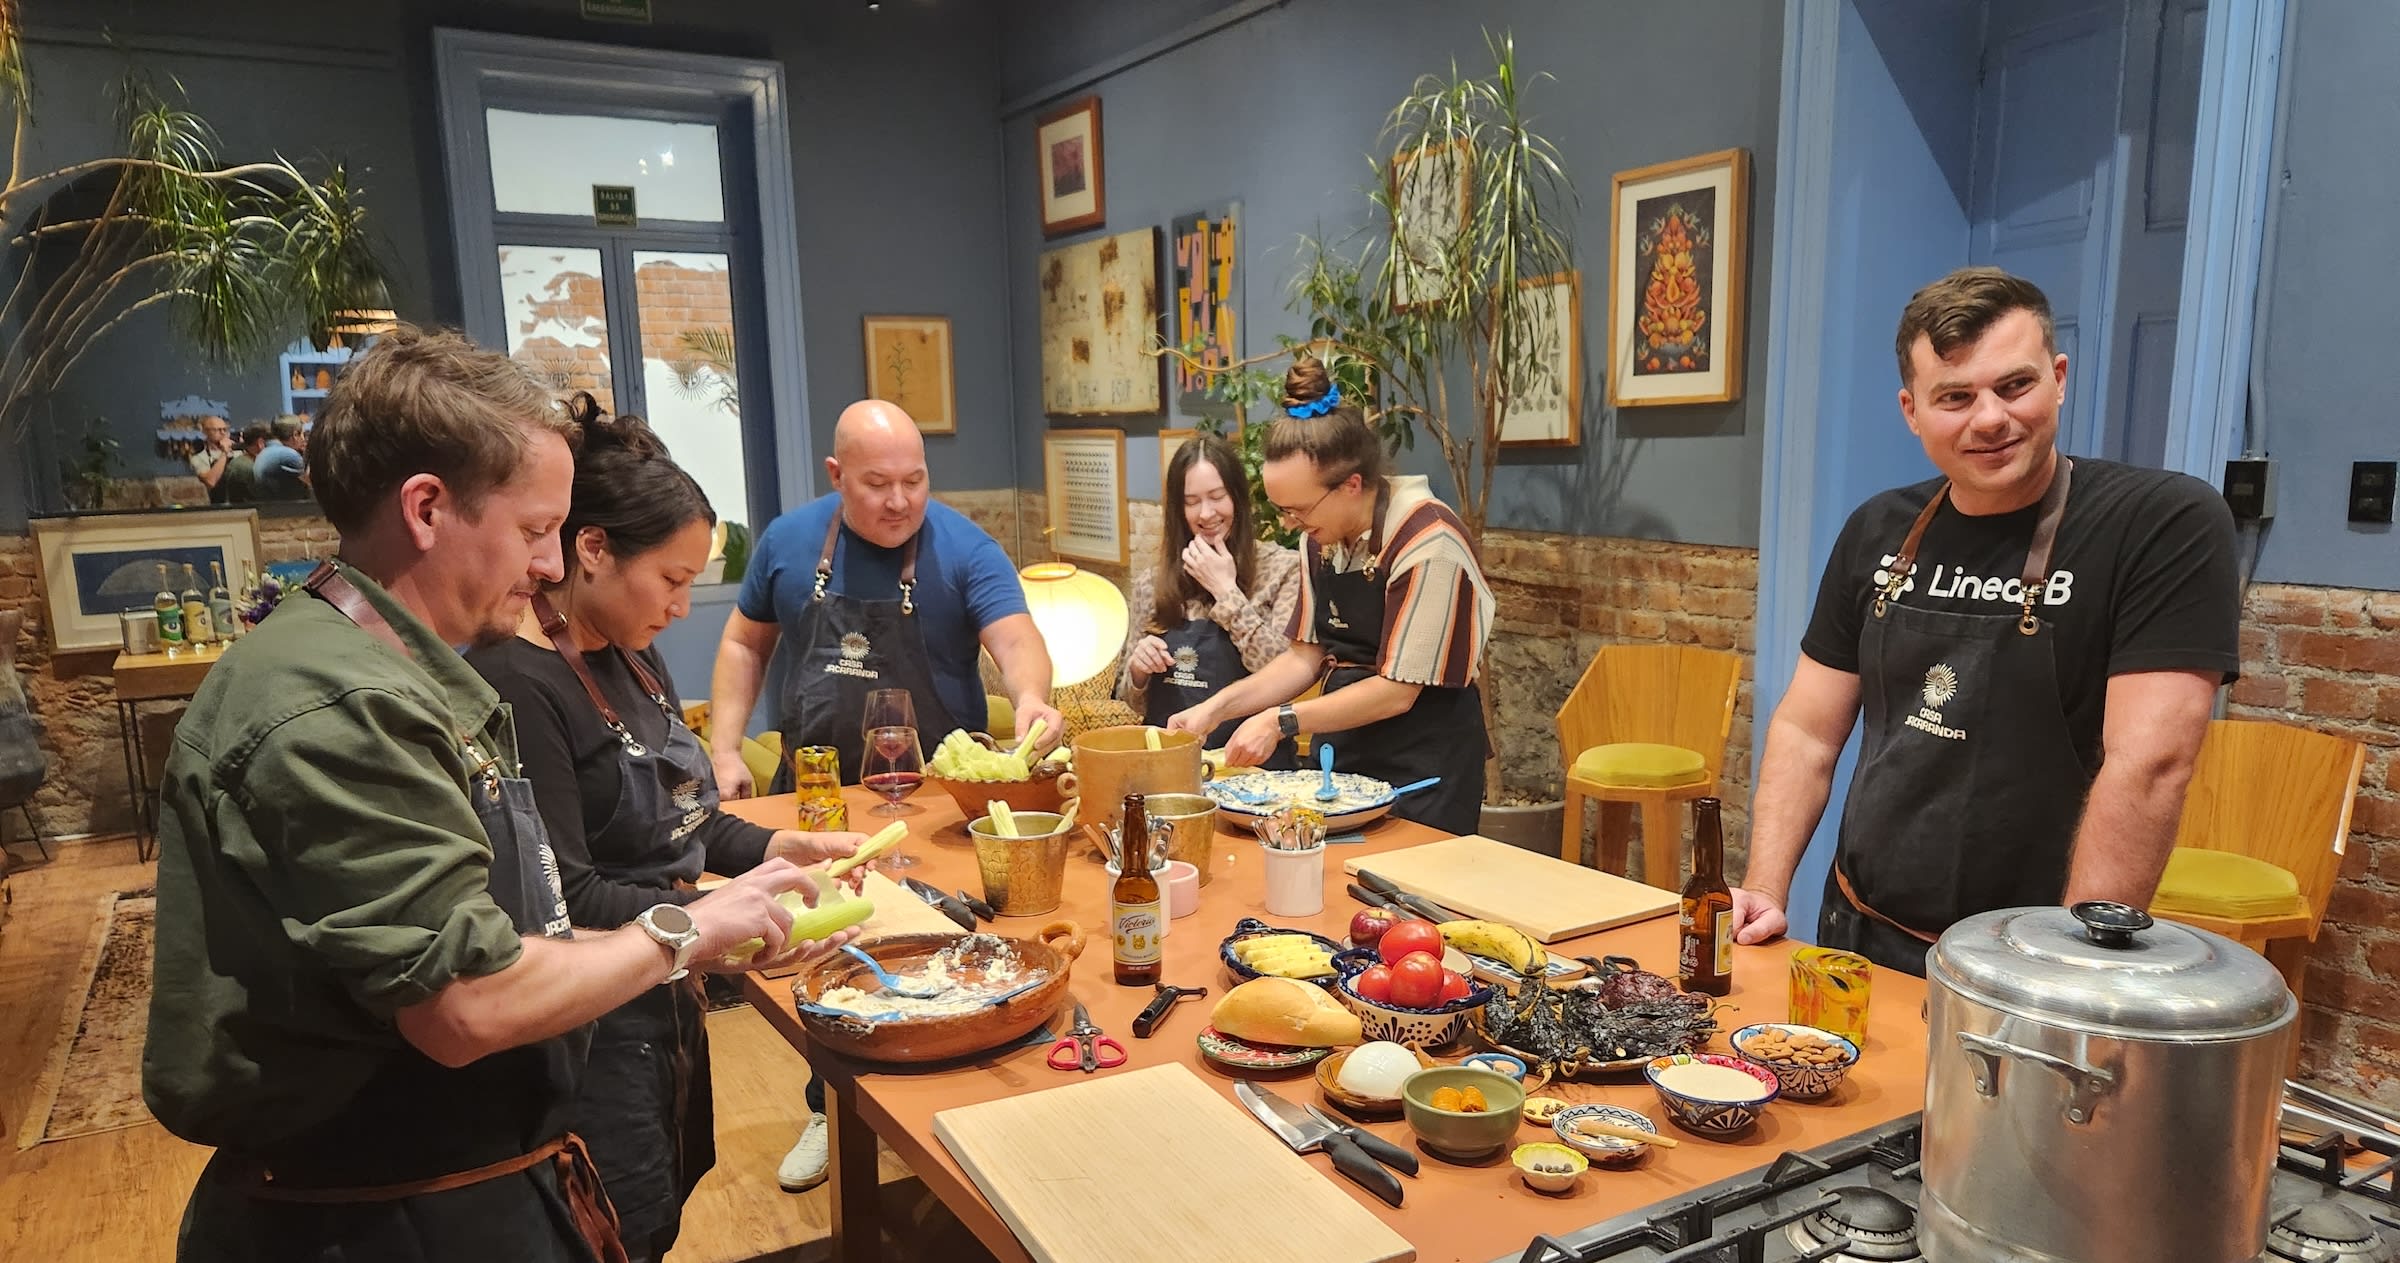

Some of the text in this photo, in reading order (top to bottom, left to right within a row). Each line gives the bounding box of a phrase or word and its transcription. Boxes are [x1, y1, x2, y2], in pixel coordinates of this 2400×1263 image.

[1928, 564, 2074, 606] LineaB
[824, 663, 879, 680] JACARANDA
[839, 658, 864, 670] CASA
[1919, 706, 1943, 724] CASA
[1904, 714, 1967, 740] JACARANDA
